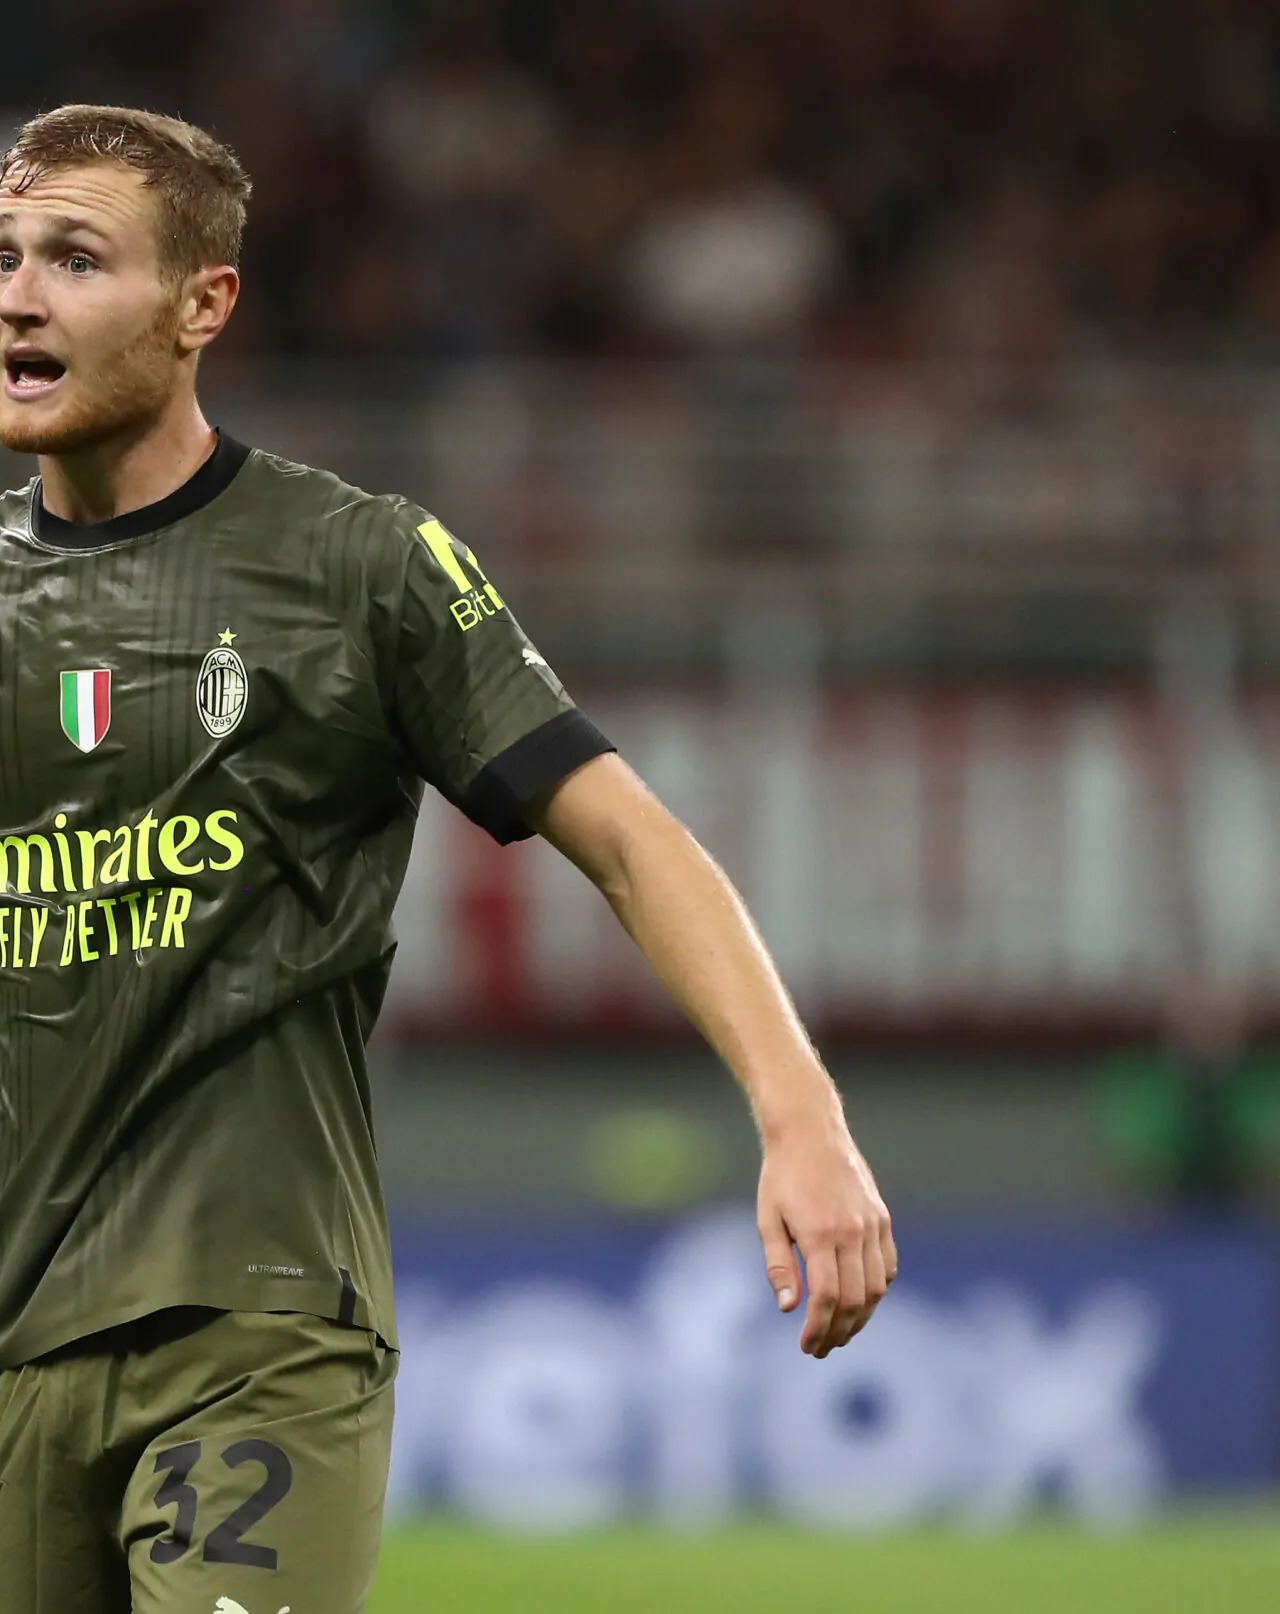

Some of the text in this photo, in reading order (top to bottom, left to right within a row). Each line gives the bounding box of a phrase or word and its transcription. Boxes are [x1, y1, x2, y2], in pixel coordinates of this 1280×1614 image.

[209, 653, 237, 670] ACM
[210, 716, 232, 728] 1899
[59, 887, 193, 968] BETTER
[392, 1210, 1160, 1536] efox
[150, 1438, 293, 1570] 32
